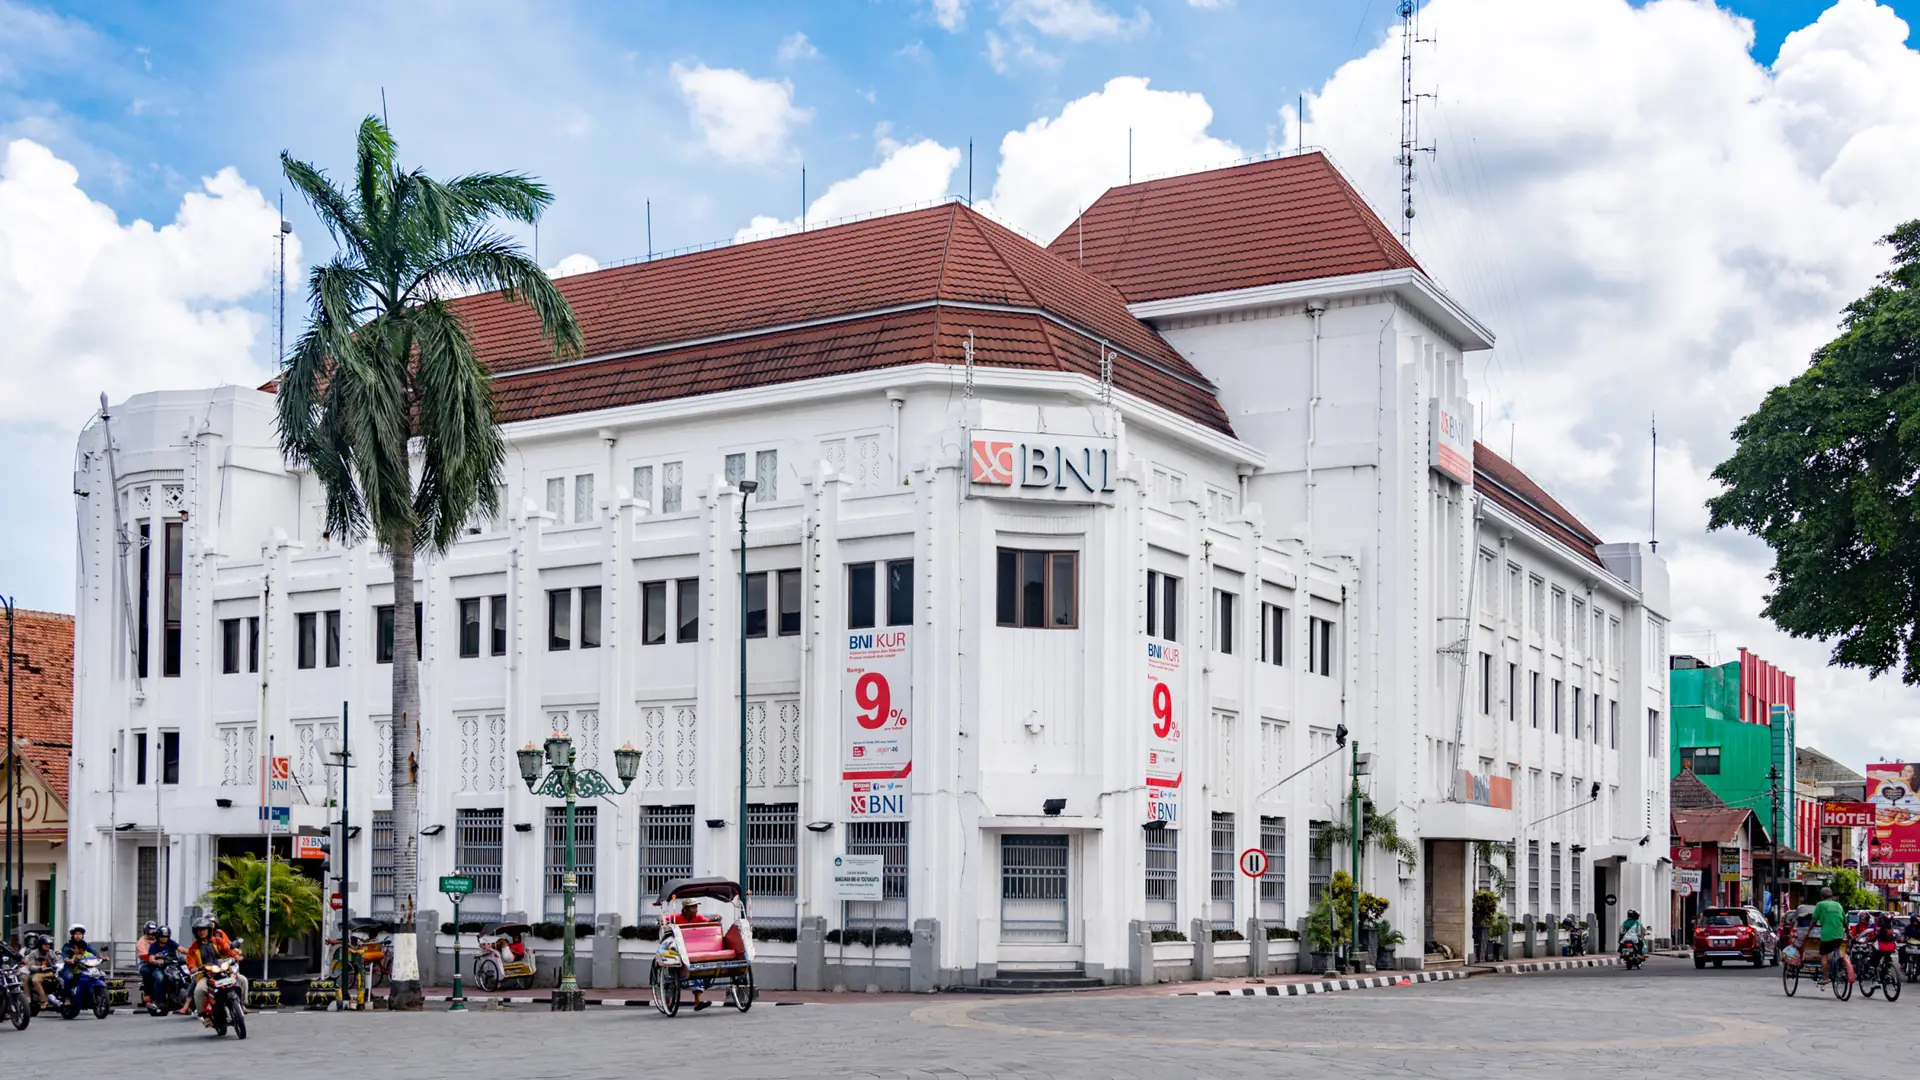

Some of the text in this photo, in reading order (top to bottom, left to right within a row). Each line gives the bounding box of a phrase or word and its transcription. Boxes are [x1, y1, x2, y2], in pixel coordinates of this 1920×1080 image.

[1020, 443, 1116, 494] BNI
[849, 632, 906, 649] BNI KUR
[1148, 643, 1180, 662] BNI KUR
[869, 795, 904, 813] BNI
[1158, 802, 1177, 821] BNI
[1825, 813, 1875, 825] HOTEL
